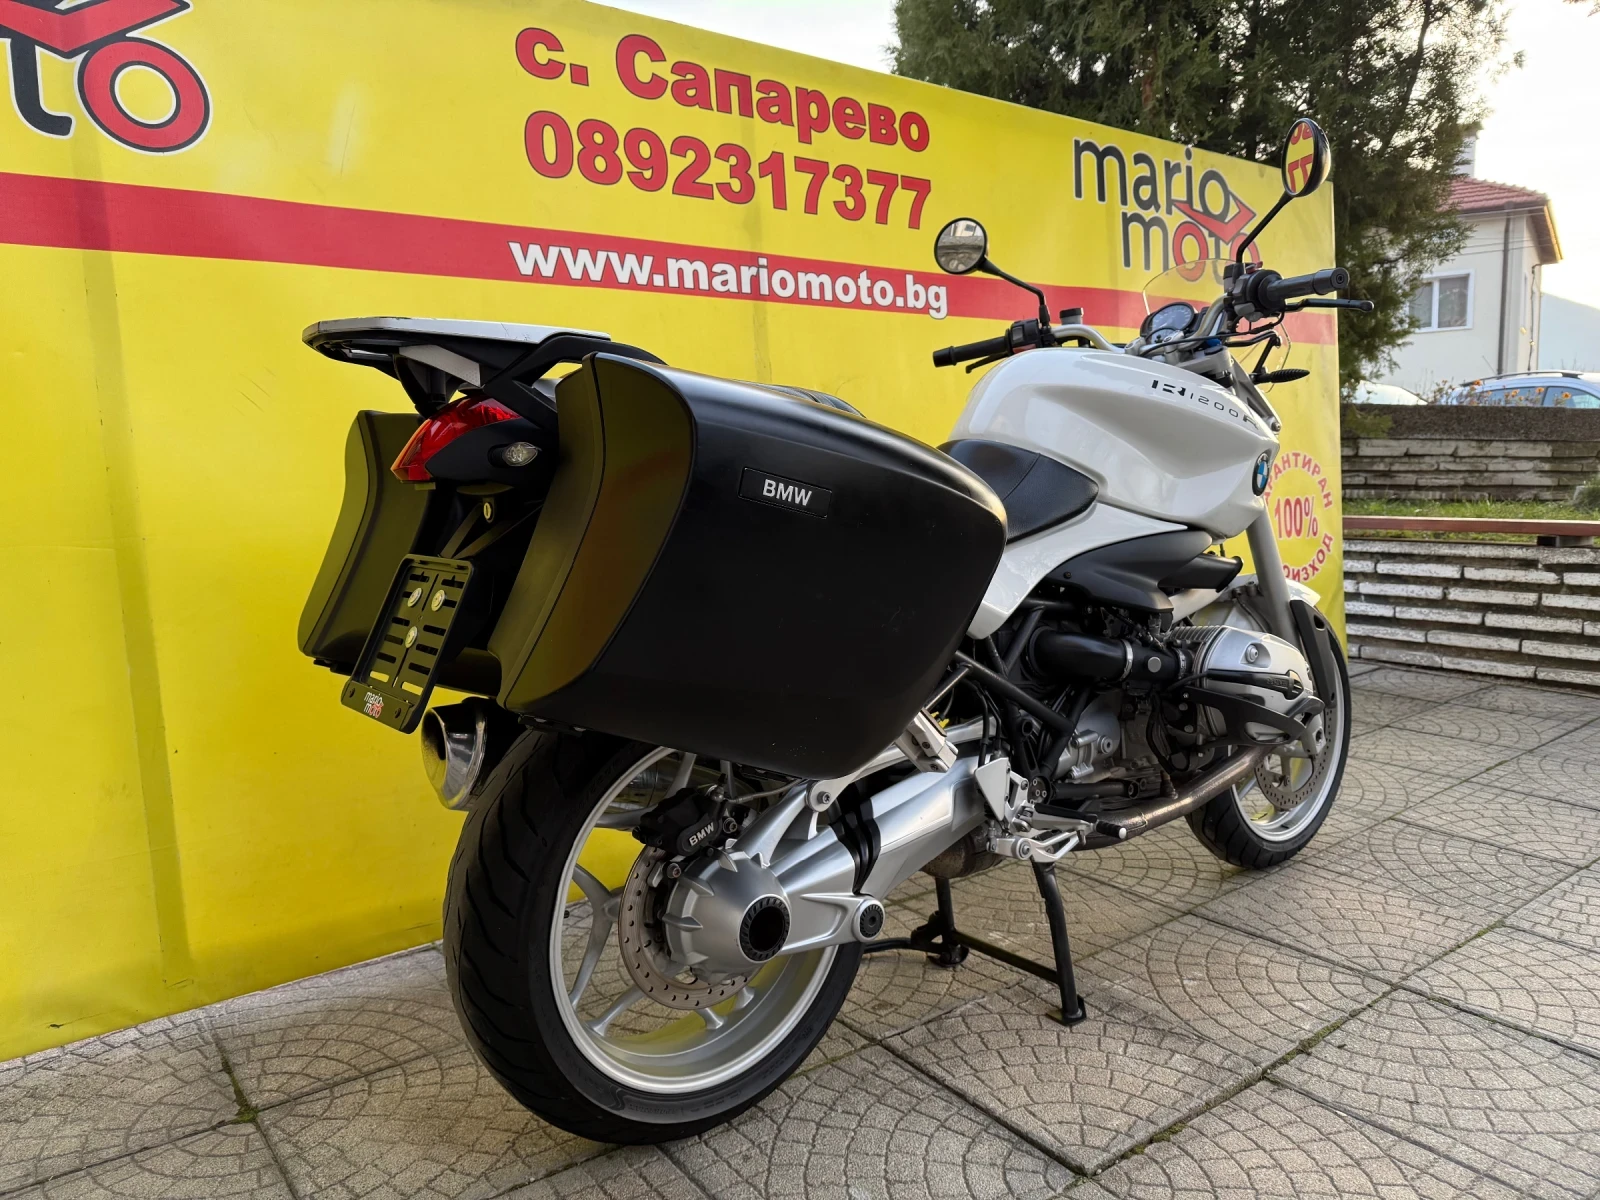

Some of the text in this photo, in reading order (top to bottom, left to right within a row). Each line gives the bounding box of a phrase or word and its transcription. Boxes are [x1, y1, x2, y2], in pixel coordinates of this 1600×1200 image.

[515, 27, 930, 152] с. Сапарево
[524, 110, 931, 230] 0892317377
[1073, 137, 1231, 223] mario
[507, 240, 948, 320] www.mariomoto.bg
[762, 478, 813, 507] BMW
[1274, 496, 1319, 539] 100%
[688, 821, 715, 847] BMW
